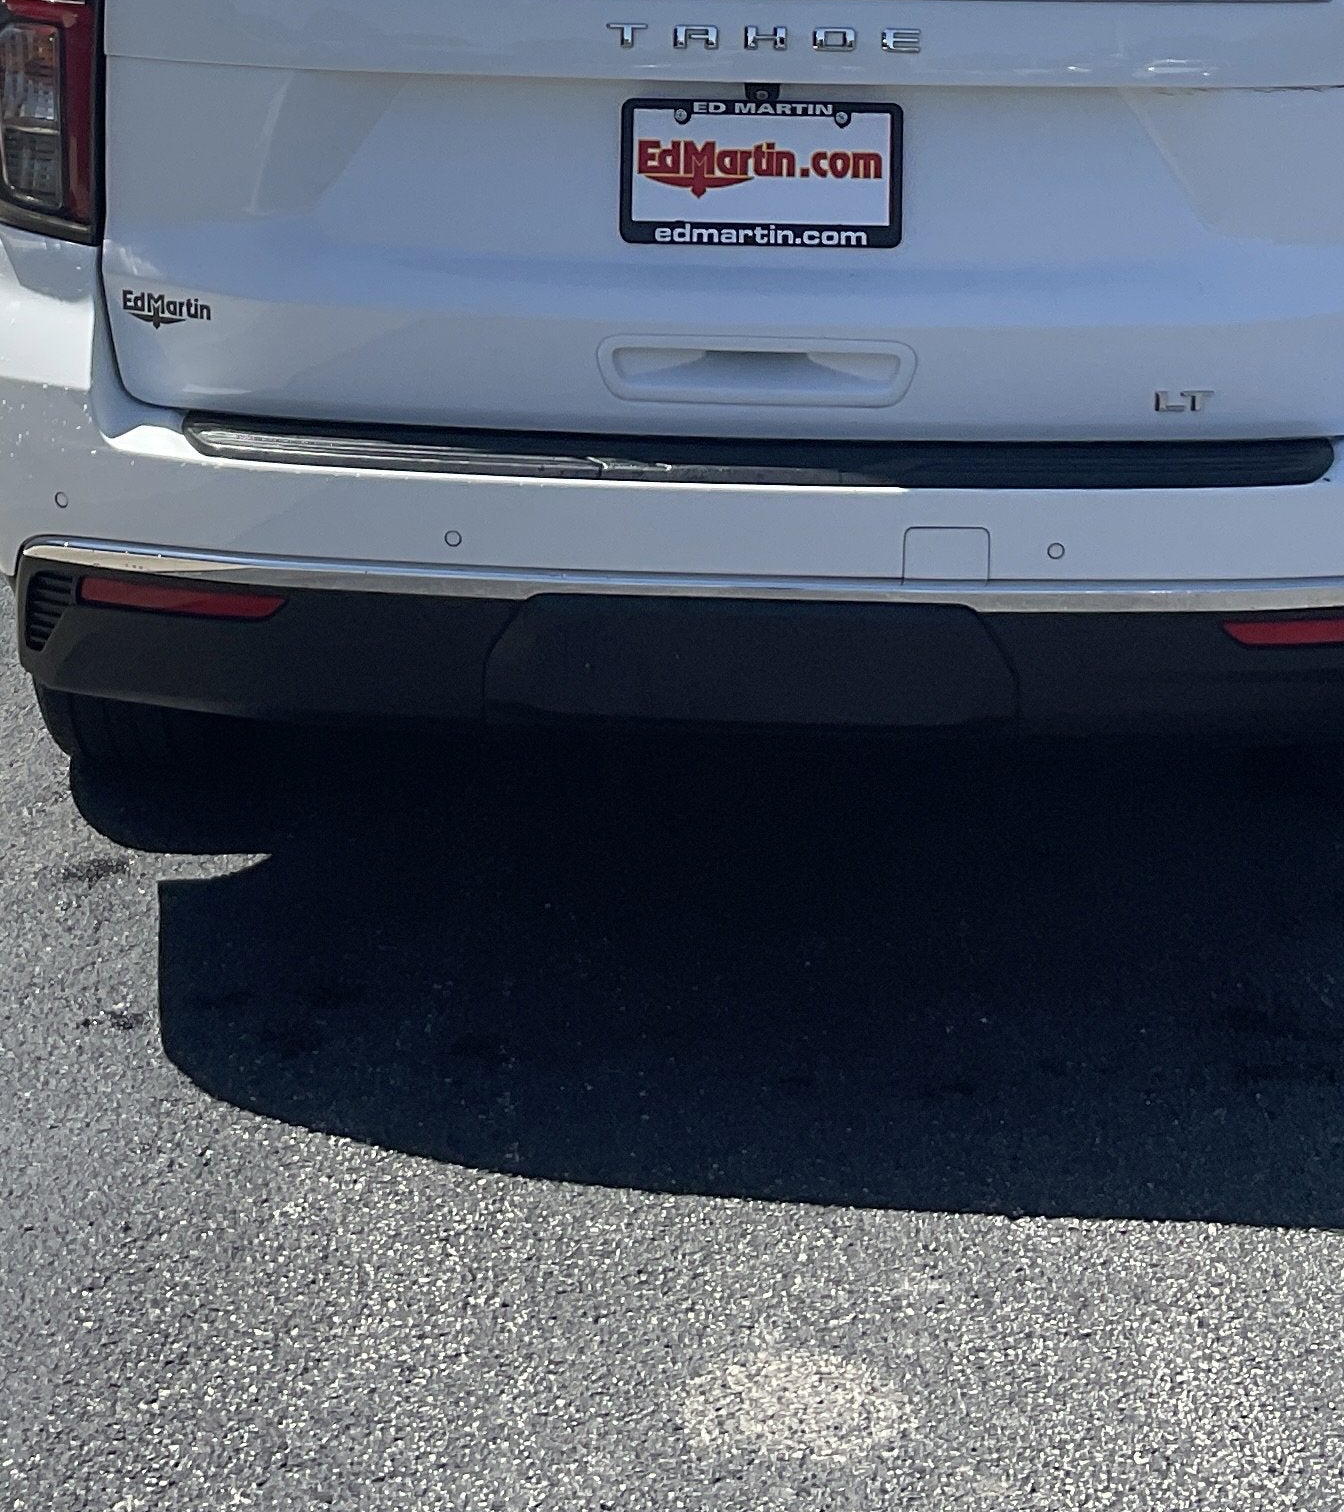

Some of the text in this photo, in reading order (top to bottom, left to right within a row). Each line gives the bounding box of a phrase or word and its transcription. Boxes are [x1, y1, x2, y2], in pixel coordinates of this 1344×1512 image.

[606, 22, 922, 54] TAHOE
[693, 101, 834, 116] ED MARTIN
[637, 139, 883, 180] EdMartin.com
[654, 223, 868, 246] edmartin.com
[122, 289, 211, 321] EdMartin
[1154, 390, 1215, 412] LT
